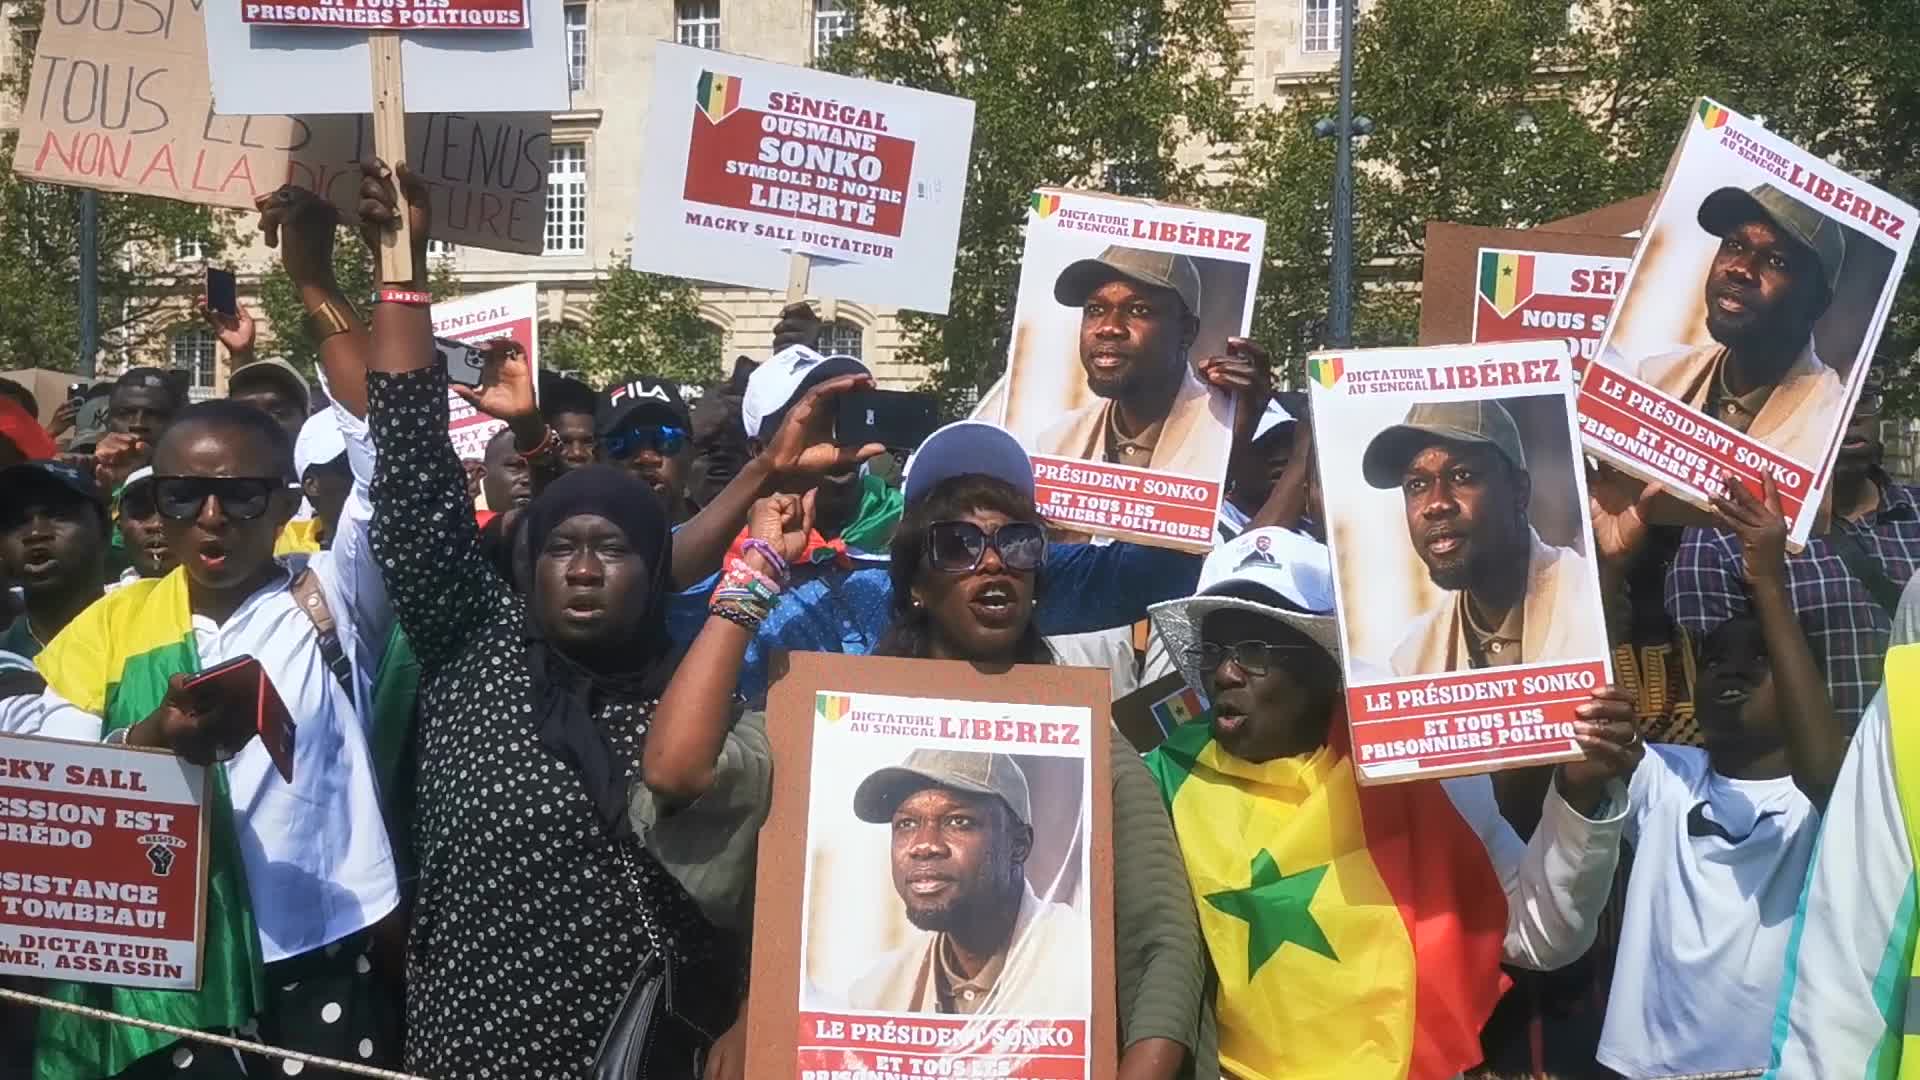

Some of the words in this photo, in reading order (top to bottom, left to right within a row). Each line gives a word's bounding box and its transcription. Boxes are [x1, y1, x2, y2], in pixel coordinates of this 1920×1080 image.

[247, 5, 393, 24] PRISONNIERS
[399, 8, 521, 25] POLITIQUES
[39, 55, 169, 135] TOUS
[767, 91, 888, 132] SÉNÉGAL
[761, 115, 876, 152] OUSMANE
[1720, 136, 1737, 151] AU
[35, 130, 132, 178] NON
[191, 149, 259, 197] LA
[758, 136, 882, 182] SONKO
[726, 160, 811, 186] SYMBOLE
[815, 175, 838, 192] DE
[841, 181, 902, 204] NOTRE
[1723, 126, 1790, 169] DICTATURE
[1788, 164, 1905, 240] LIBÉREZ
[750, 183, 876, 226] LIBERTÉ
[685, 212, 749, 233] MACKY
[753, 223, 796, 241] SALL
[801, 231, 894, 259] DICTATEUR
[1058, 219, 1075, 229] AU
[1059, 208, 1129, 227] DICTATURE
[1132, 218, 1252, 252] LIBÉREZ
[1521, 309, 1585, 330] NOUS
[1591, 314, 1608, 331] S
[1347, 368, 1424, 383] DICTATURE
[1426, 358, 1560, 391] LIBÉREZ
[1348, 383, 1367, 395] AU
[610, 381, 671, 407] FILA
[1599, 376, 1626, 400] LE
[1628, 390, 1734, 457] PRÉSIDENT
[1735, 446, 1801, 489] SONKO
[1636, 427, 1660, 447] ET
[1663, 440, 1708, 471] TOUS
[1034, 463, 1140, 492] PRÉSIDENT
[1143, 480, 1208, 502] SONKO
[1050, 491, 1072, 505] ET
[1077, 495, 1120, 513] TOUS
[1124, 503, 1155, 517] LES
[1110, 514, 1210, 539] POLITIQUES
[1364, 692, 1392, 712] LE
[1396, 679, 1518, 709] PRÉSIDENT
[1523, 670, 1595, 695] SONKO
[850, 723, 870, 733] AU
[851, 711, 934, 726] DICTATURE
[939, 716, 1080, 745] LIBÉREZ
[1424, 720, 1448, 736] ET
[1454, 714, 1504, 732] TOUS
[1509, 708, 1544, 725] LES
[1360, 732, 1493, 761] PRISONNIERS
[1498, 723, 1575, 745] POLITIQ
[65, 764, 147, 792] SALL
[115, 808, 175, 833] EST
[0, 871, 158, 905] SISTANCE
[3, 896, 167, 928] TOMBEAU!
[19, 933, 169, 962] DICTATEUR
[55, 954, 183, 979] ASSASSIN
[815, 1019, 845, 1040] LE
[851, 1021, 986, 1046] PRÉSIDENT
[991, 1026, 1074, 1047] SONKO
[876, 1055, 903, 1072] ET
[909, 1058, 966, 1076] TOUS
